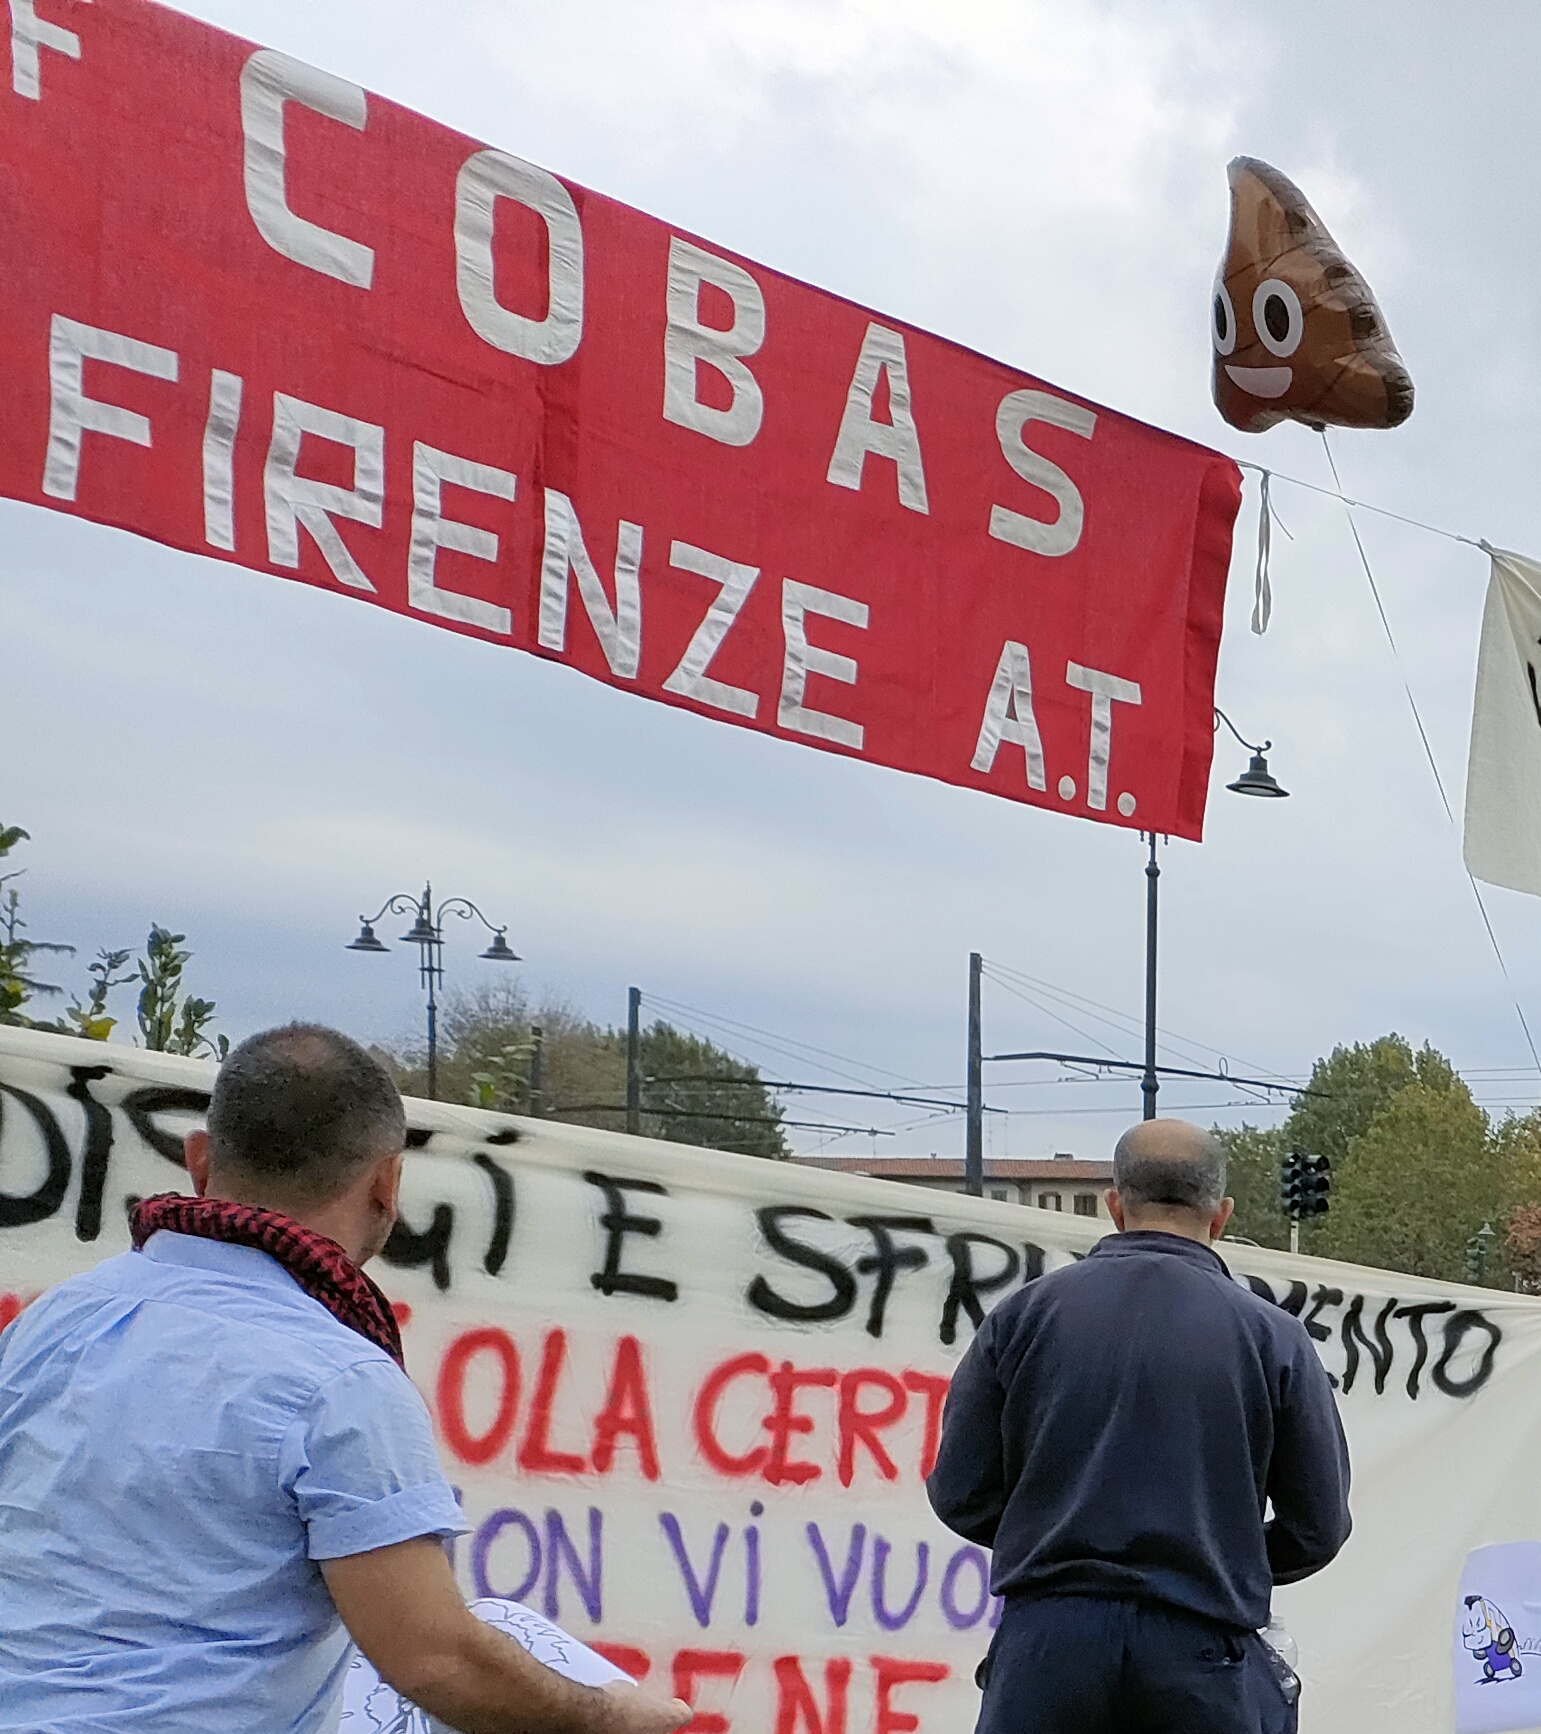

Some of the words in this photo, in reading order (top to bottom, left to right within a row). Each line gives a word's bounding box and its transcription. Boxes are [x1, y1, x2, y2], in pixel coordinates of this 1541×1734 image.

[240, 48, 1099, 558] COBAS
[42, 312, 871, 752] FIRENZE
[583, 1170, 679, 1303] E
[806, 1521, 1003, 1631] VUO
